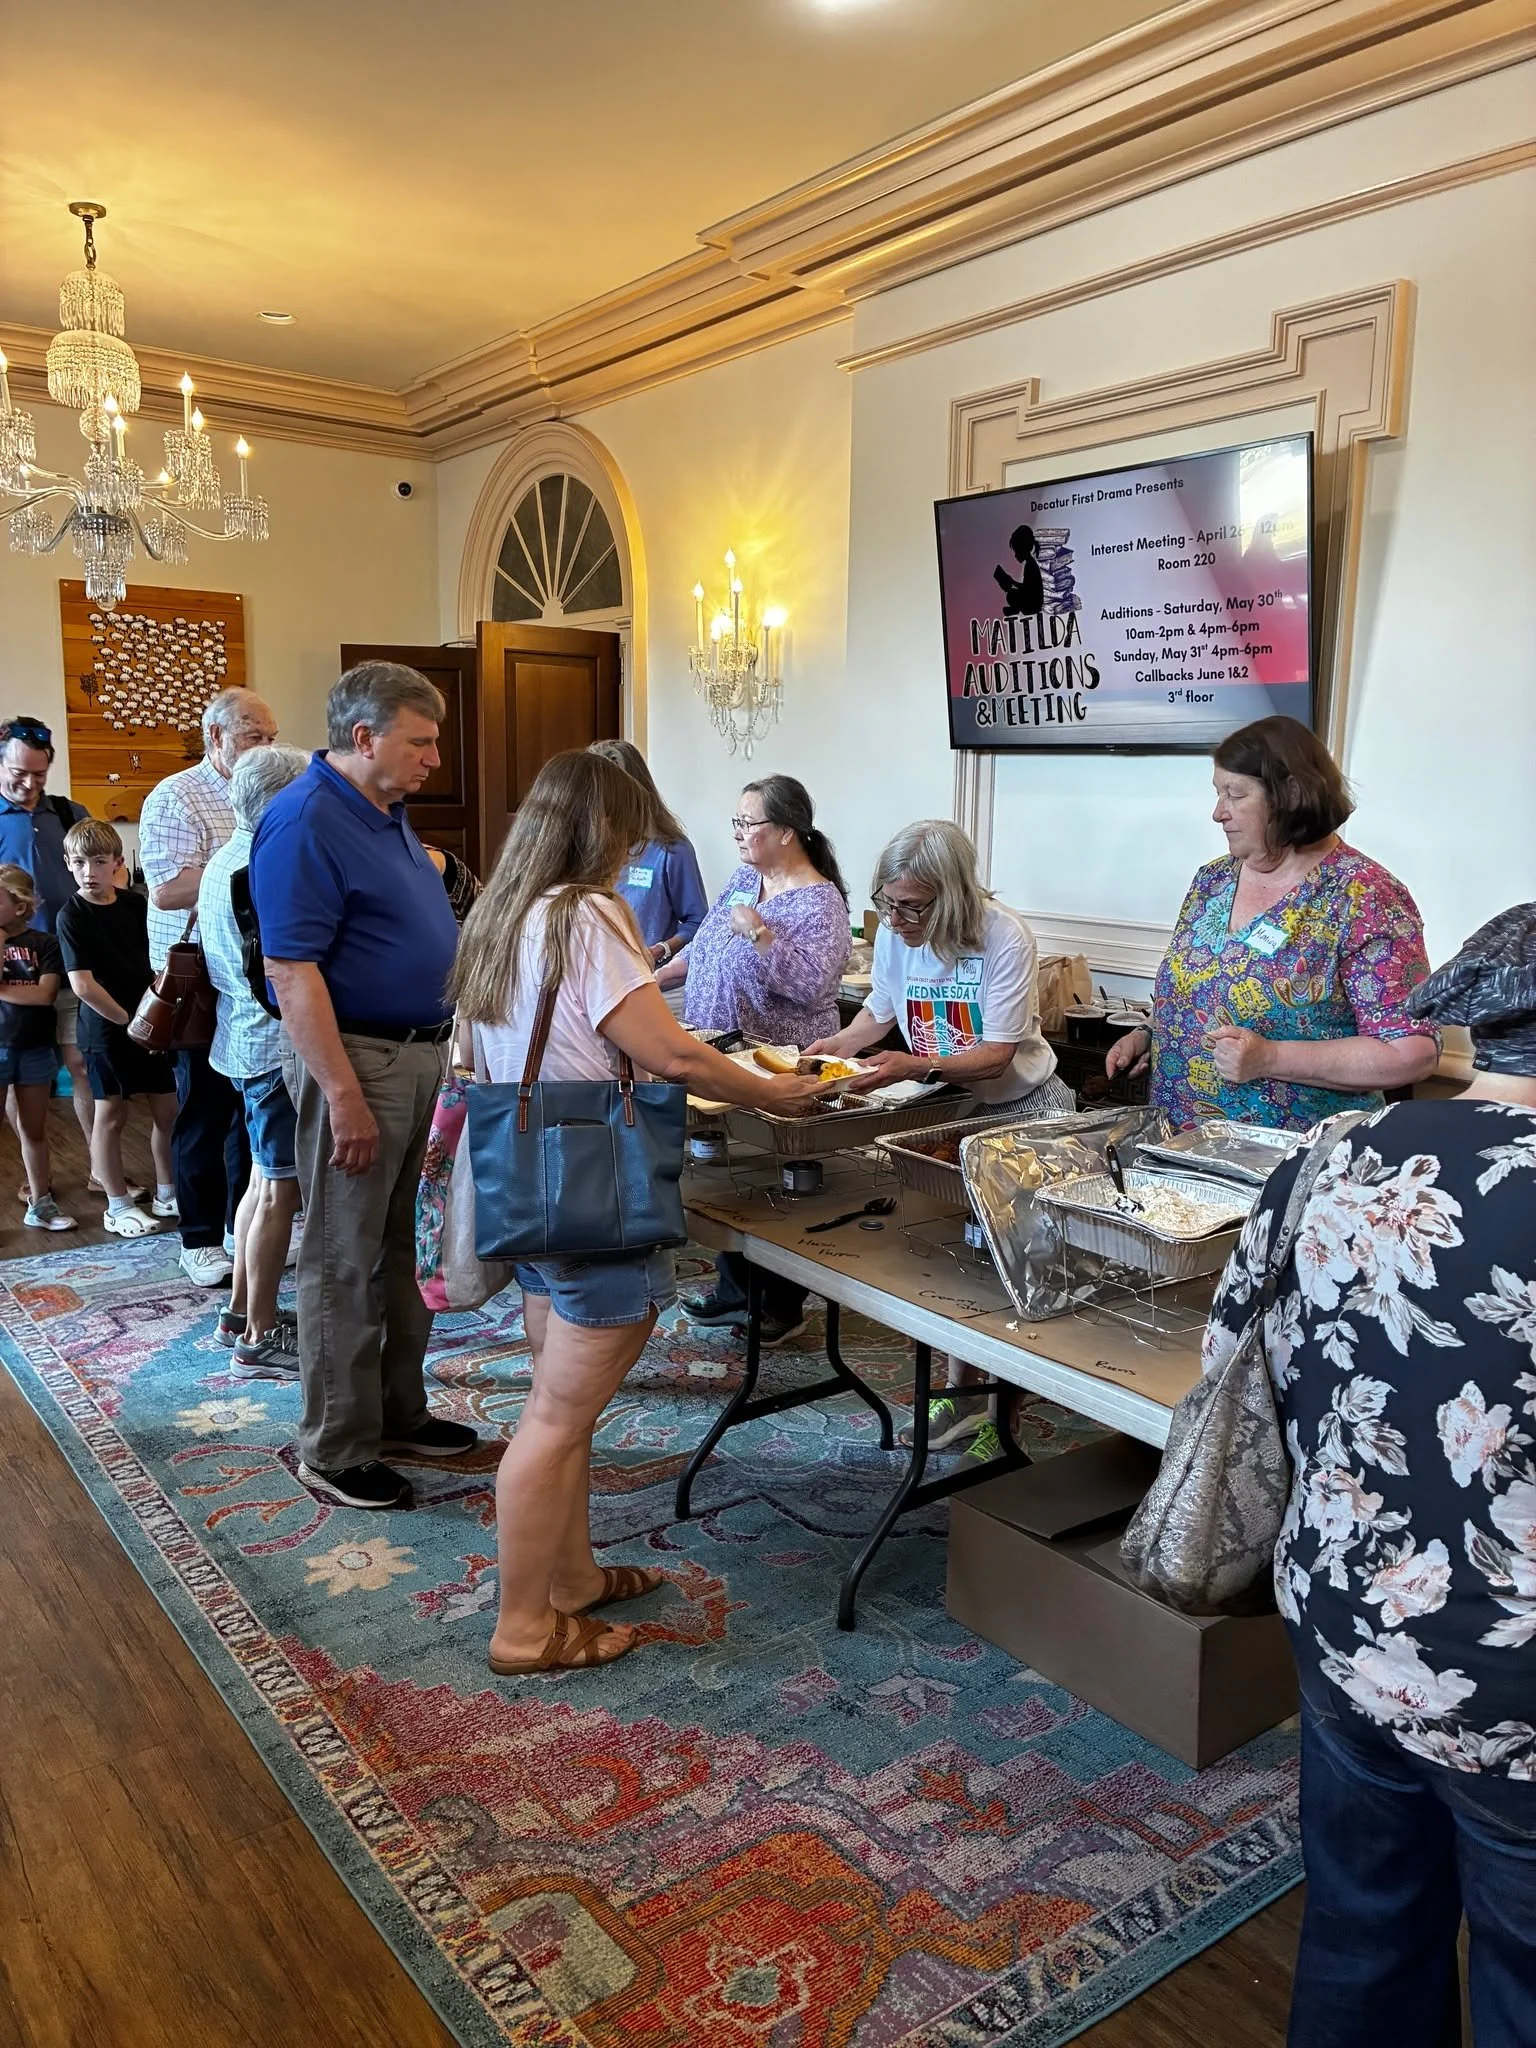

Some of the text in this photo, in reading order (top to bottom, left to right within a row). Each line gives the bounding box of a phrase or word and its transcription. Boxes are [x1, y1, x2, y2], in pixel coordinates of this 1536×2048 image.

[1031, 478, 1184, 512] Decatur First Drama Presents
[1091, 541, 1134, 556] Interest
[1136, 534, 1186, 550] Meeting
[1197, 526, 1227, 545] April
[1158, 552, 1216, 571] Room 220
[1100, 607, 1154, 621] Auditions
[1164, 598, 1223, 616] Saturday,
[1226, 595, 1255, 612] May
[971, 611, 1082, 656] MATILDA
[1125, 620, 1260, 642] 10am-2pm & 4pm-6pm
[1113, 649, 1159, 665] Sunday,
[1161, 647, 1188, 662] May
[1211, 644, 1273, 660] 4pm-6pm
[963, 653, 1101, 697] AUDITIONS
[1135, 666, 1249, 683] Callbacks June 1&2
[1168, 687, 1215, 703] 3rd floor
[907, 984, 978, 1000] WEDNESDAY
[1095, 1360, 1137, 1376] Buns
